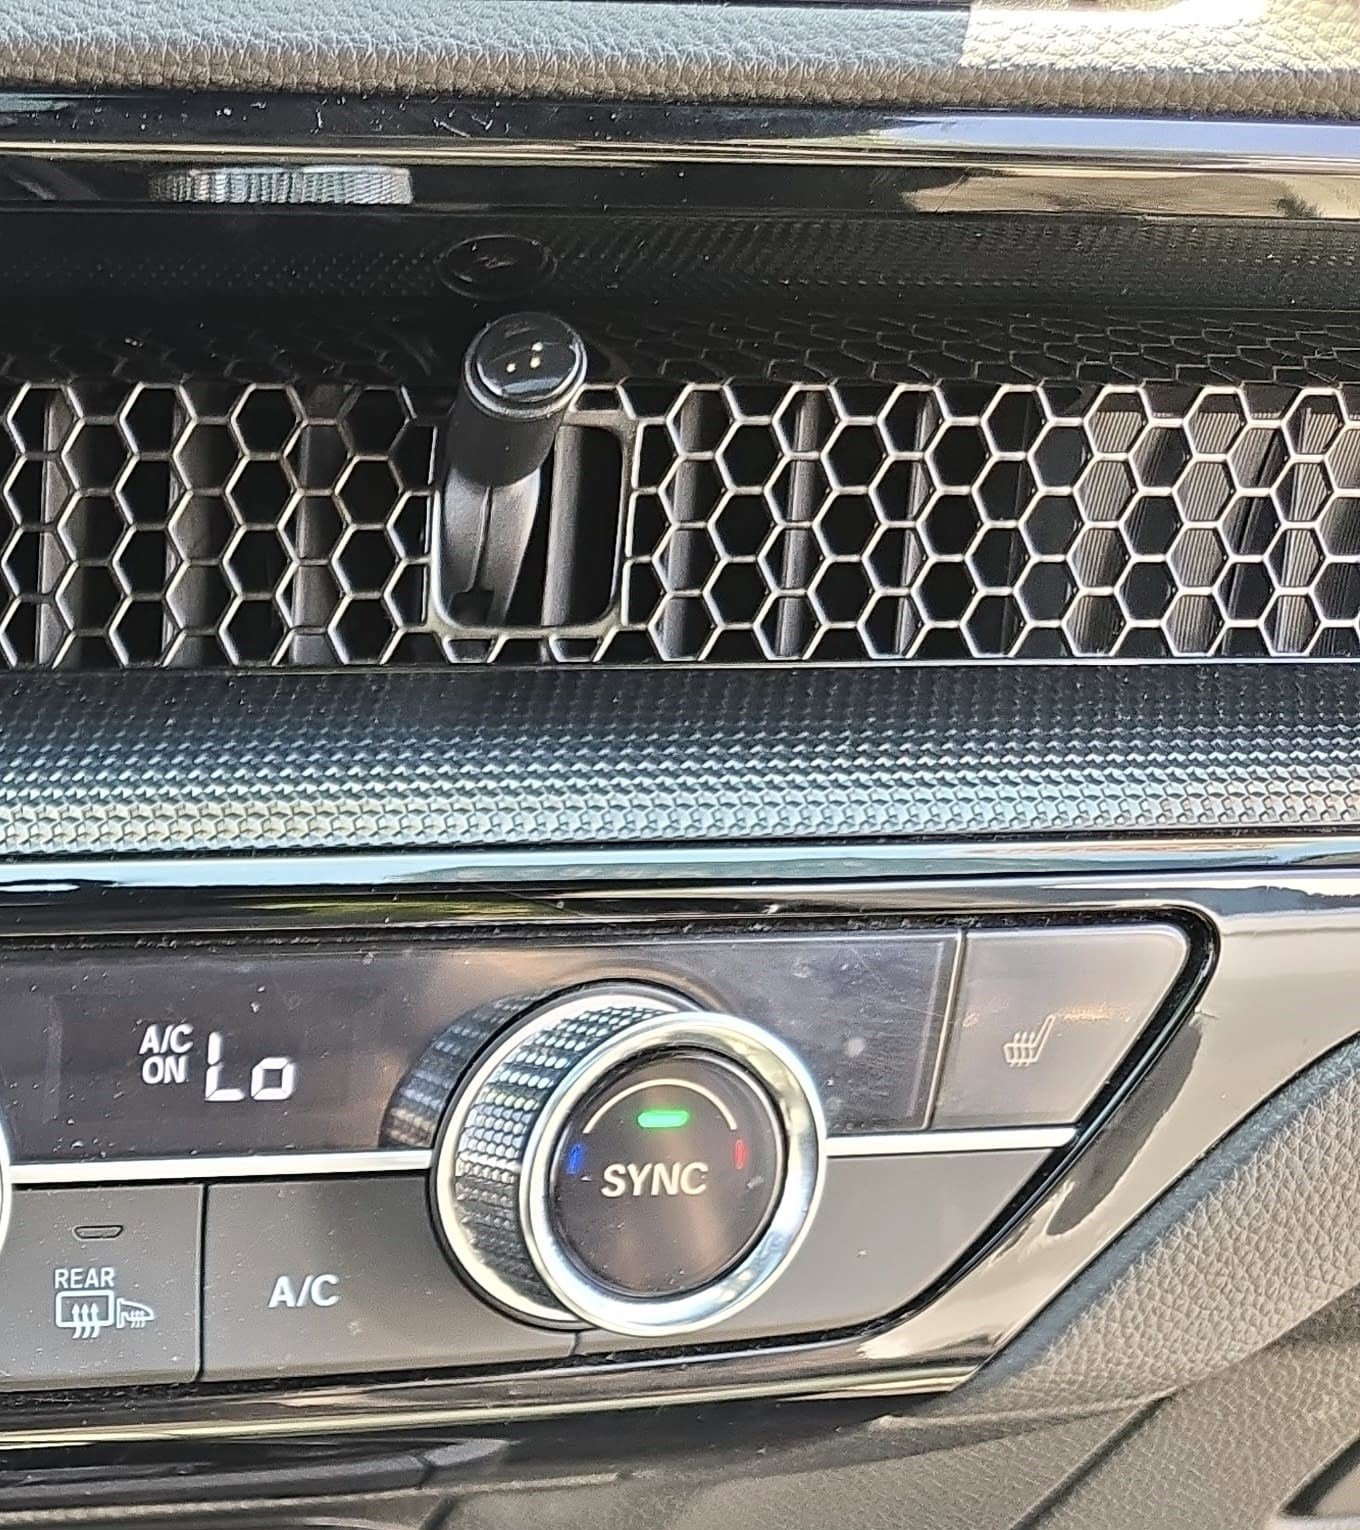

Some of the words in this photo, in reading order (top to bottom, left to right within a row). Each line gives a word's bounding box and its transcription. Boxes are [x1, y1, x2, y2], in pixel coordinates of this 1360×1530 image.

[138, 1023, 194, 1053] A/C
[140, 1054, 188, 1086] ON
[600, 1162, 710, 1198] SYNC
[52, 1267, 118, 1292] REAR
[268, 1272, 342, 1308] A/C
